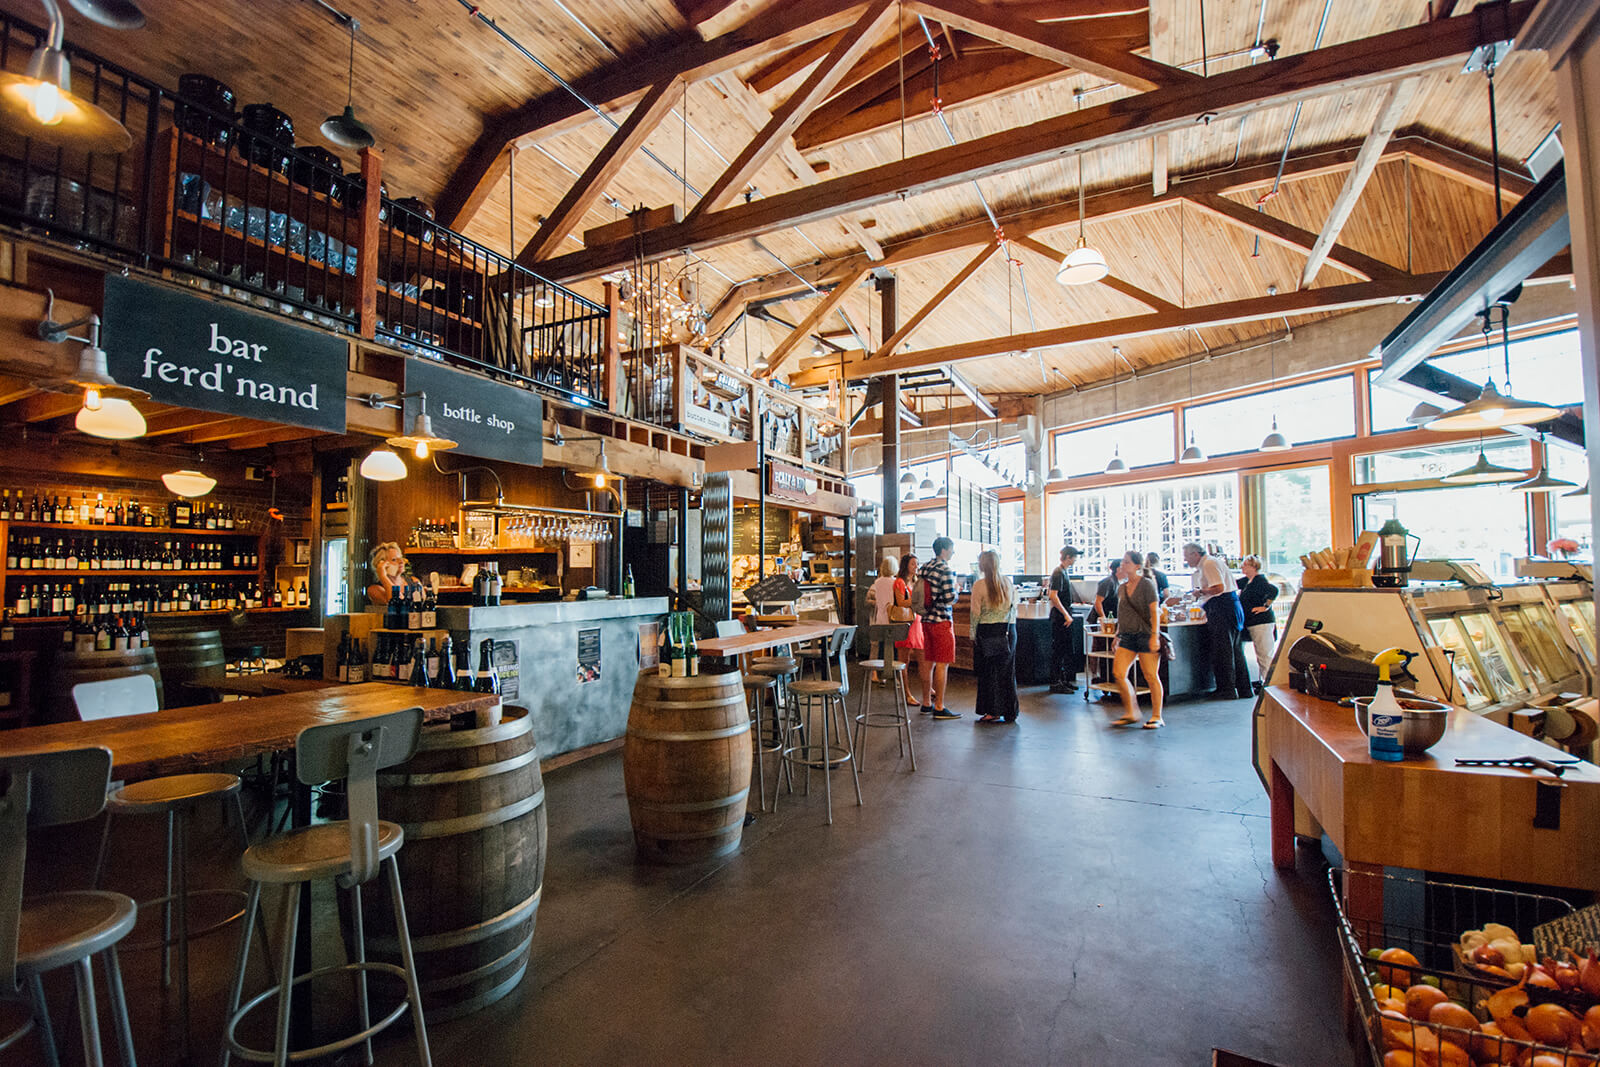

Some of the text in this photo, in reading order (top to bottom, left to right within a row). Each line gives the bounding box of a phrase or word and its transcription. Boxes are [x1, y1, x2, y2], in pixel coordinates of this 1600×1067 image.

[208, 323, 268, 363] bar
[142, 348, 319, 410] ferd'nand
[443, 402, 515, 434] bottle shop
